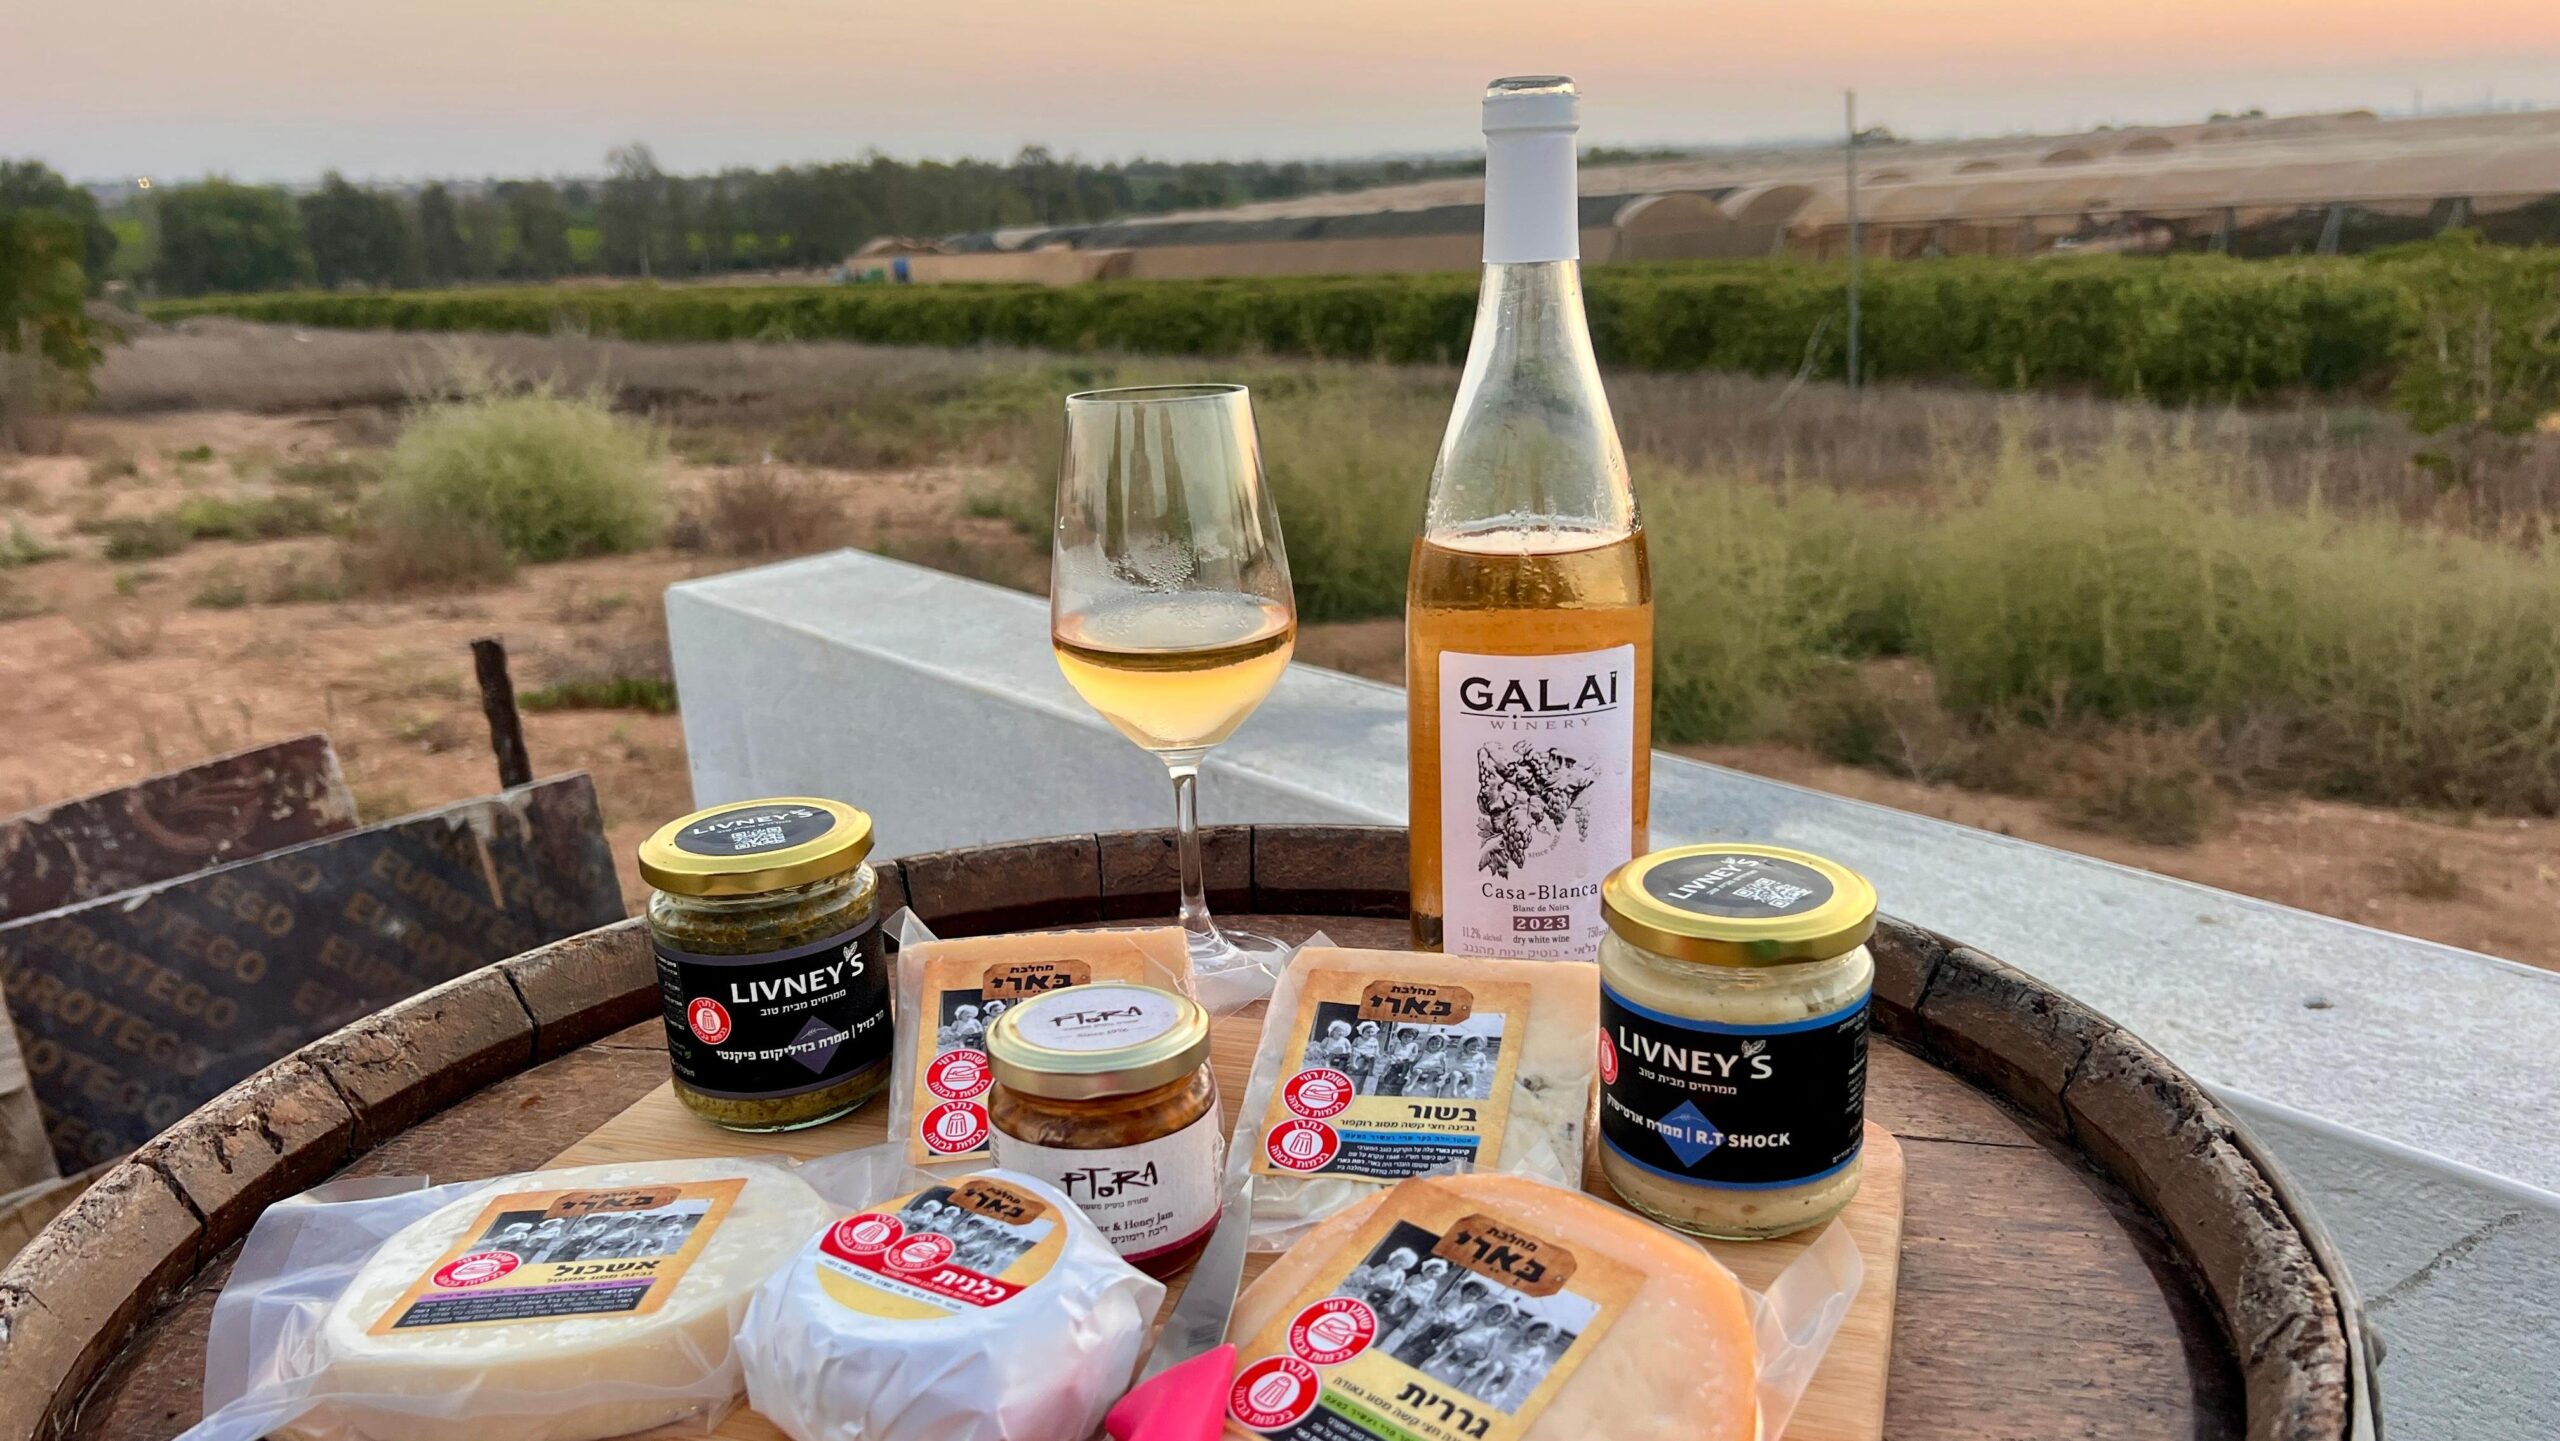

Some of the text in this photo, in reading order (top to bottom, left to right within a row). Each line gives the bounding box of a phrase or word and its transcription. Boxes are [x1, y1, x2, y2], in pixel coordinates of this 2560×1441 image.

[1490, 717, 1591, 731] WINERY
[1482, 883, 1598, 900] Casa-Blanca
[1549, 904, 1570, 912] Noirs
[1516, 917, 1567, 930] 2023
[1513, 936, 1526, 945] dry
[1528, 935, 1550, 943] white
[1528, 949, 1559, 959] בוטיק
[1574, 944, 1597, 955] גלאי
[730, 952, 864, 1003] LIVNEY'S
[1010, 964, 1054, 973] מחלבת
[1390, 985, 1437, 996] מחלבת
[696, 1000, 716, 1009] נתרן
[760, 989, 847, 1016] ממרחים מבית טוב
[818, 1030, 849, 1048] ממרח
[716, 1050, 757, 1064] פיקנטי
[760, 1041, 816, 1061] בזיליקום
[937, 1052, 986, 1065] שומן רווי
[1619, 1025, 1773, 1079] LIVNEY'S
[1299, 1071, 1348, 1087] שומן רווי
[1638, 1067, 1737, 1095] ממרחים מבית טוב
[931, 1080, 989, 1098] בכמות גבוהה
[943, 1102, 974, 1113] נתרן
[1287, 1094, 1345, 1118] בכמות גבוהה
[1408, 1104, 1478, 1122] בשור
[1294, 1120, 1325, 1132] נתרן
[1341, 1119, 1372, 1128] רוקפור
[1401, 1122, 1425, 1131] קשה
[1646, 1118, 1683, 1139] ממרח
[926, 1132, 953, 1150] גבוהה
[956, 1129, 987, 1150] בכמות
[1696, 1130, 1724, 1146] R.T
[1728, 1132, 1791, 1148] SHOCK
[1270, 1144, 1330, 1169] בכמות גבוהה
[1113, 1222, 1122, 1231] &
[1124, 1218, 1155, 1230] Honey
[1157, 1211, 1174, 1225] Jam
[1111, 1225, 1168, 1245] ריבת רימונים
[1486, 1226, 1538, 1253] מחלבת
[554, 1260, 661, 1276] אשכול
[931, 1270, 1006, 1300] כלנית
[1323, 1300, 1372, 1330] שומן רווי
[1308, 1349, 1353, 1363] בכמות
[1280, 1360, 1312, 1382] נתרן
[1333, 1375, 1363, 1397] גאודה
[1366, 1392, 1393, 1411] מסוג
[1396, 1381, 1490, 1439] גררית
[1392, 1407, 1420, 1427] קשה
